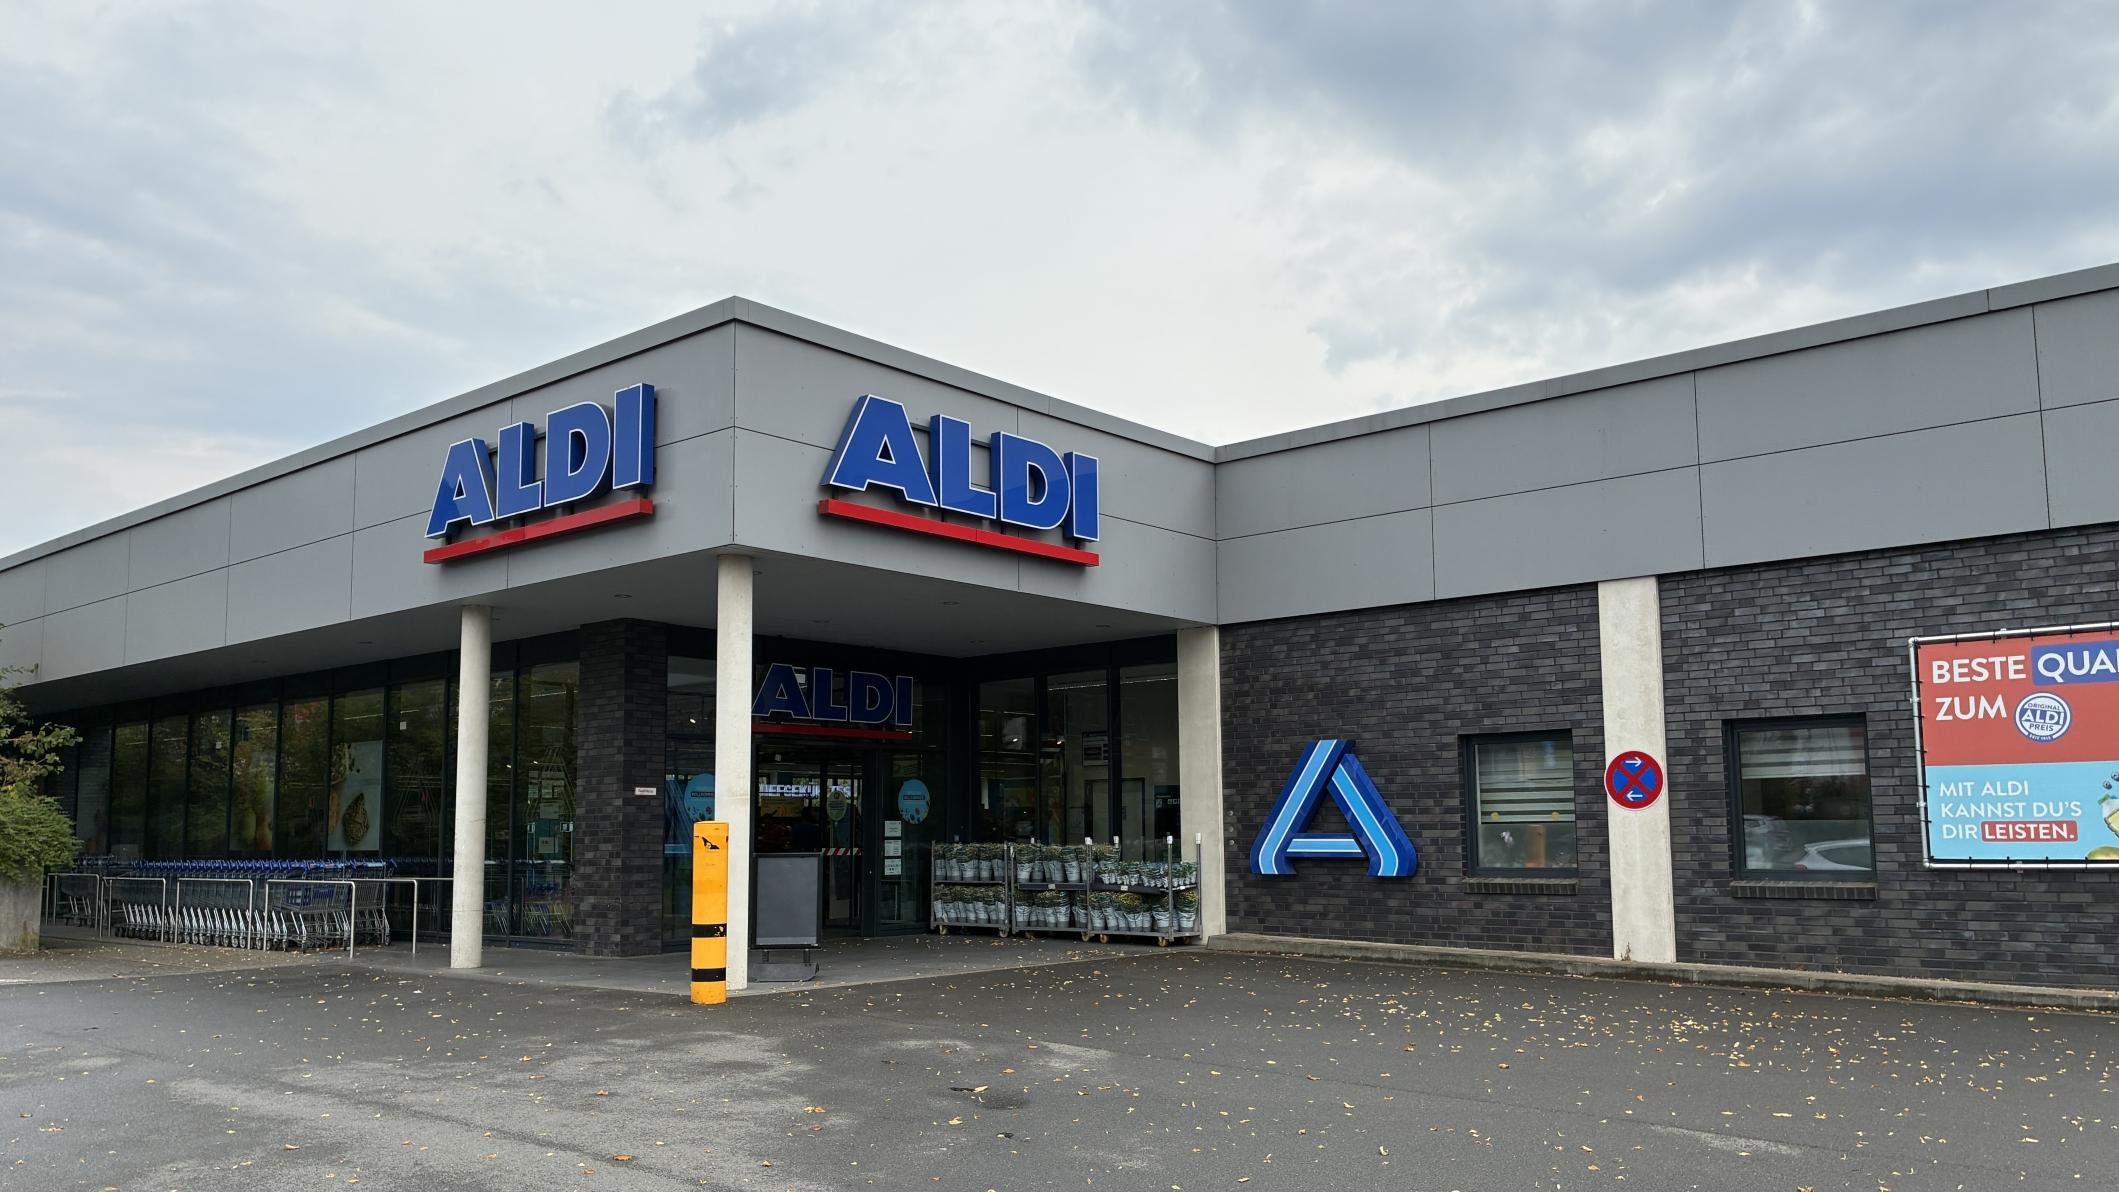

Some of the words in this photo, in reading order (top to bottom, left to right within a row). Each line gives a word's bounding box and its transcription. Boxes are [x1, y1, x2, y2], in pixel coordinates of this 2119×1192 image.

[424, 383, 655, 539] ALDI
[823, 394, 1099, 542] ALDI
[1932, 655, 2027, 684] BESTE
[2037, 648, 2119, 683] QUA
[751, 663, 913, 726] ALDI
[1935, 694, 2007, 721] ZUM
[2027, 702, 2060, 711] ORIGINAL
[2021, 708, 2065, 725] ALDI
[2029, 723, 2054, 732] PREIS
[1939, 782, 1974, 797] MIT
[1981, 780, 2029, 796] ALDI
[1941, 802, 2025, 818] KANNST
[1942, 824, 1978, 840] DIR
[1984, 823, 2075, 839] LEISTEN.
